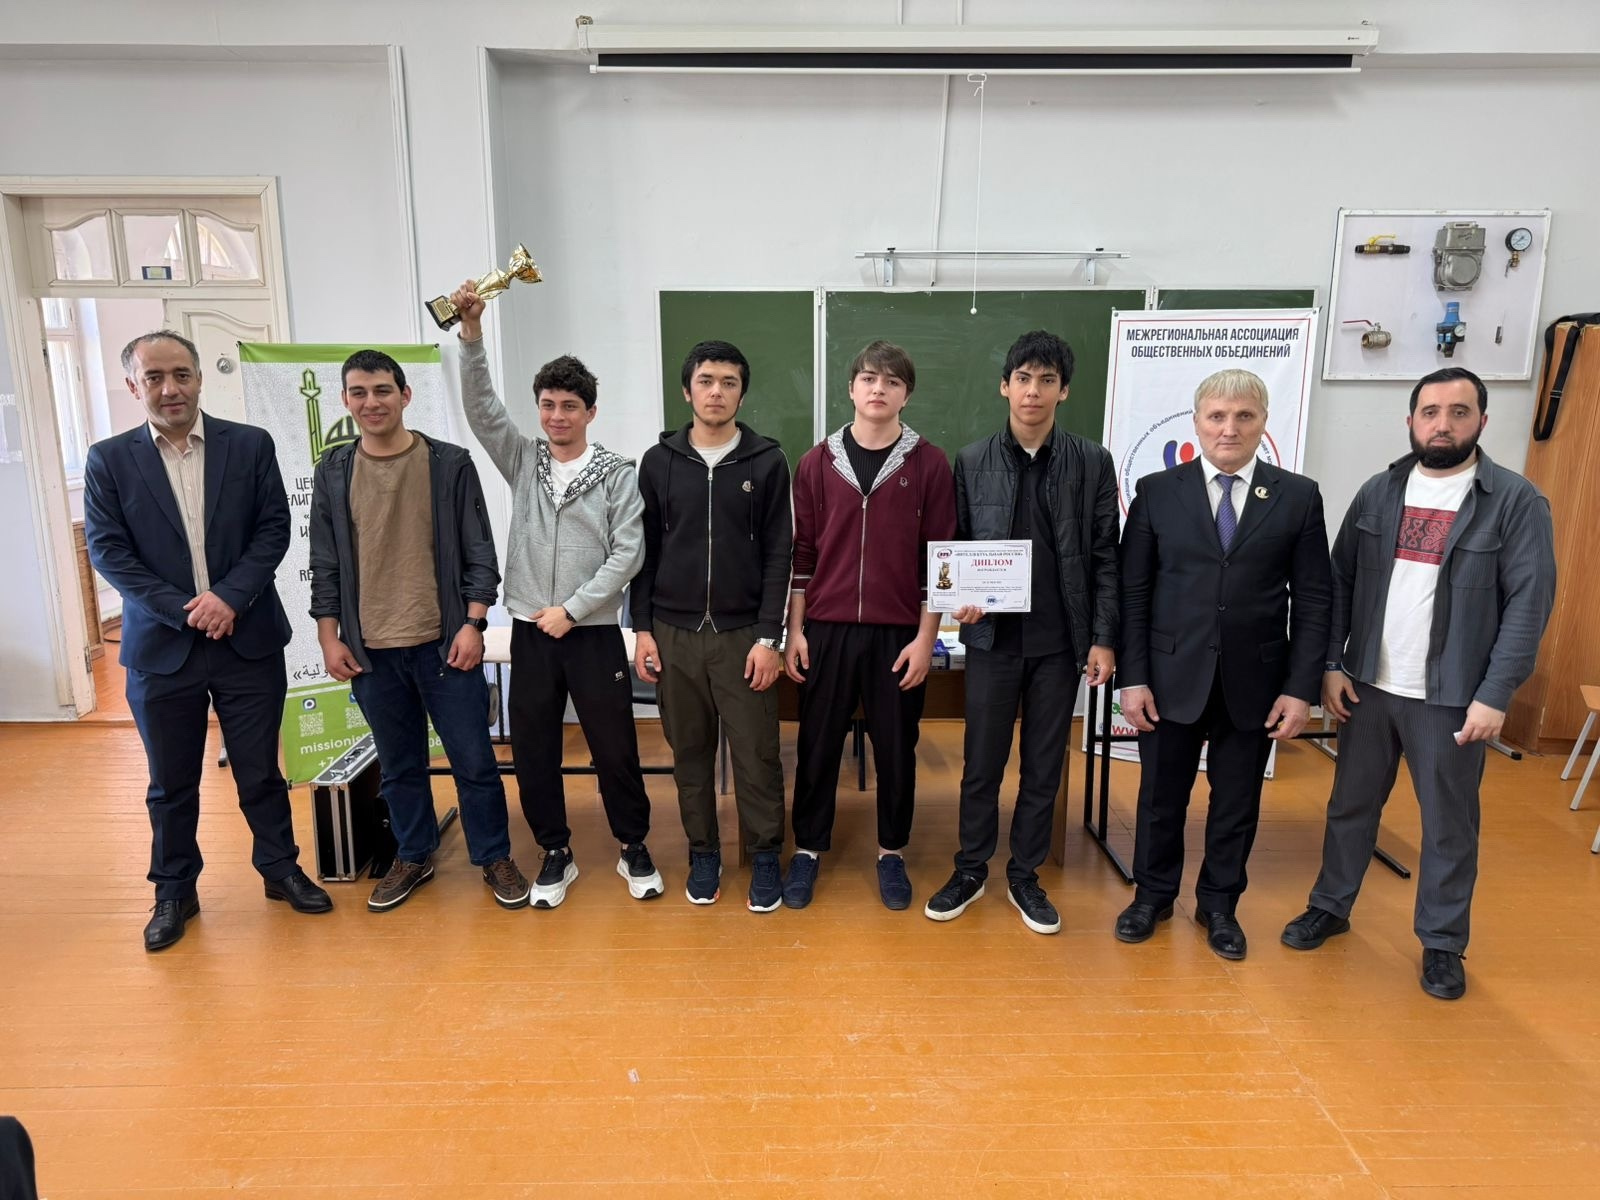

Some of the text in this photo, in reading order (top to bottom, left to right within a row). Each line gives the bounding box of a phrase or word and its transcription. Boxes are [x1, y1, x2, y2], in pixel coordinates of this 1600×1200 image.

[1126, 327, 1299, 342] МЕЖРЕГИОНАЛЬНАЯ АССОЦИАЦИЯ
[1131, 343, 1291, 359] ОБЩЕСТВЕННЫХ ОБЪЕДИНЕНИЙ
[971, 559, 1013, 567] ДИПЛОМ
